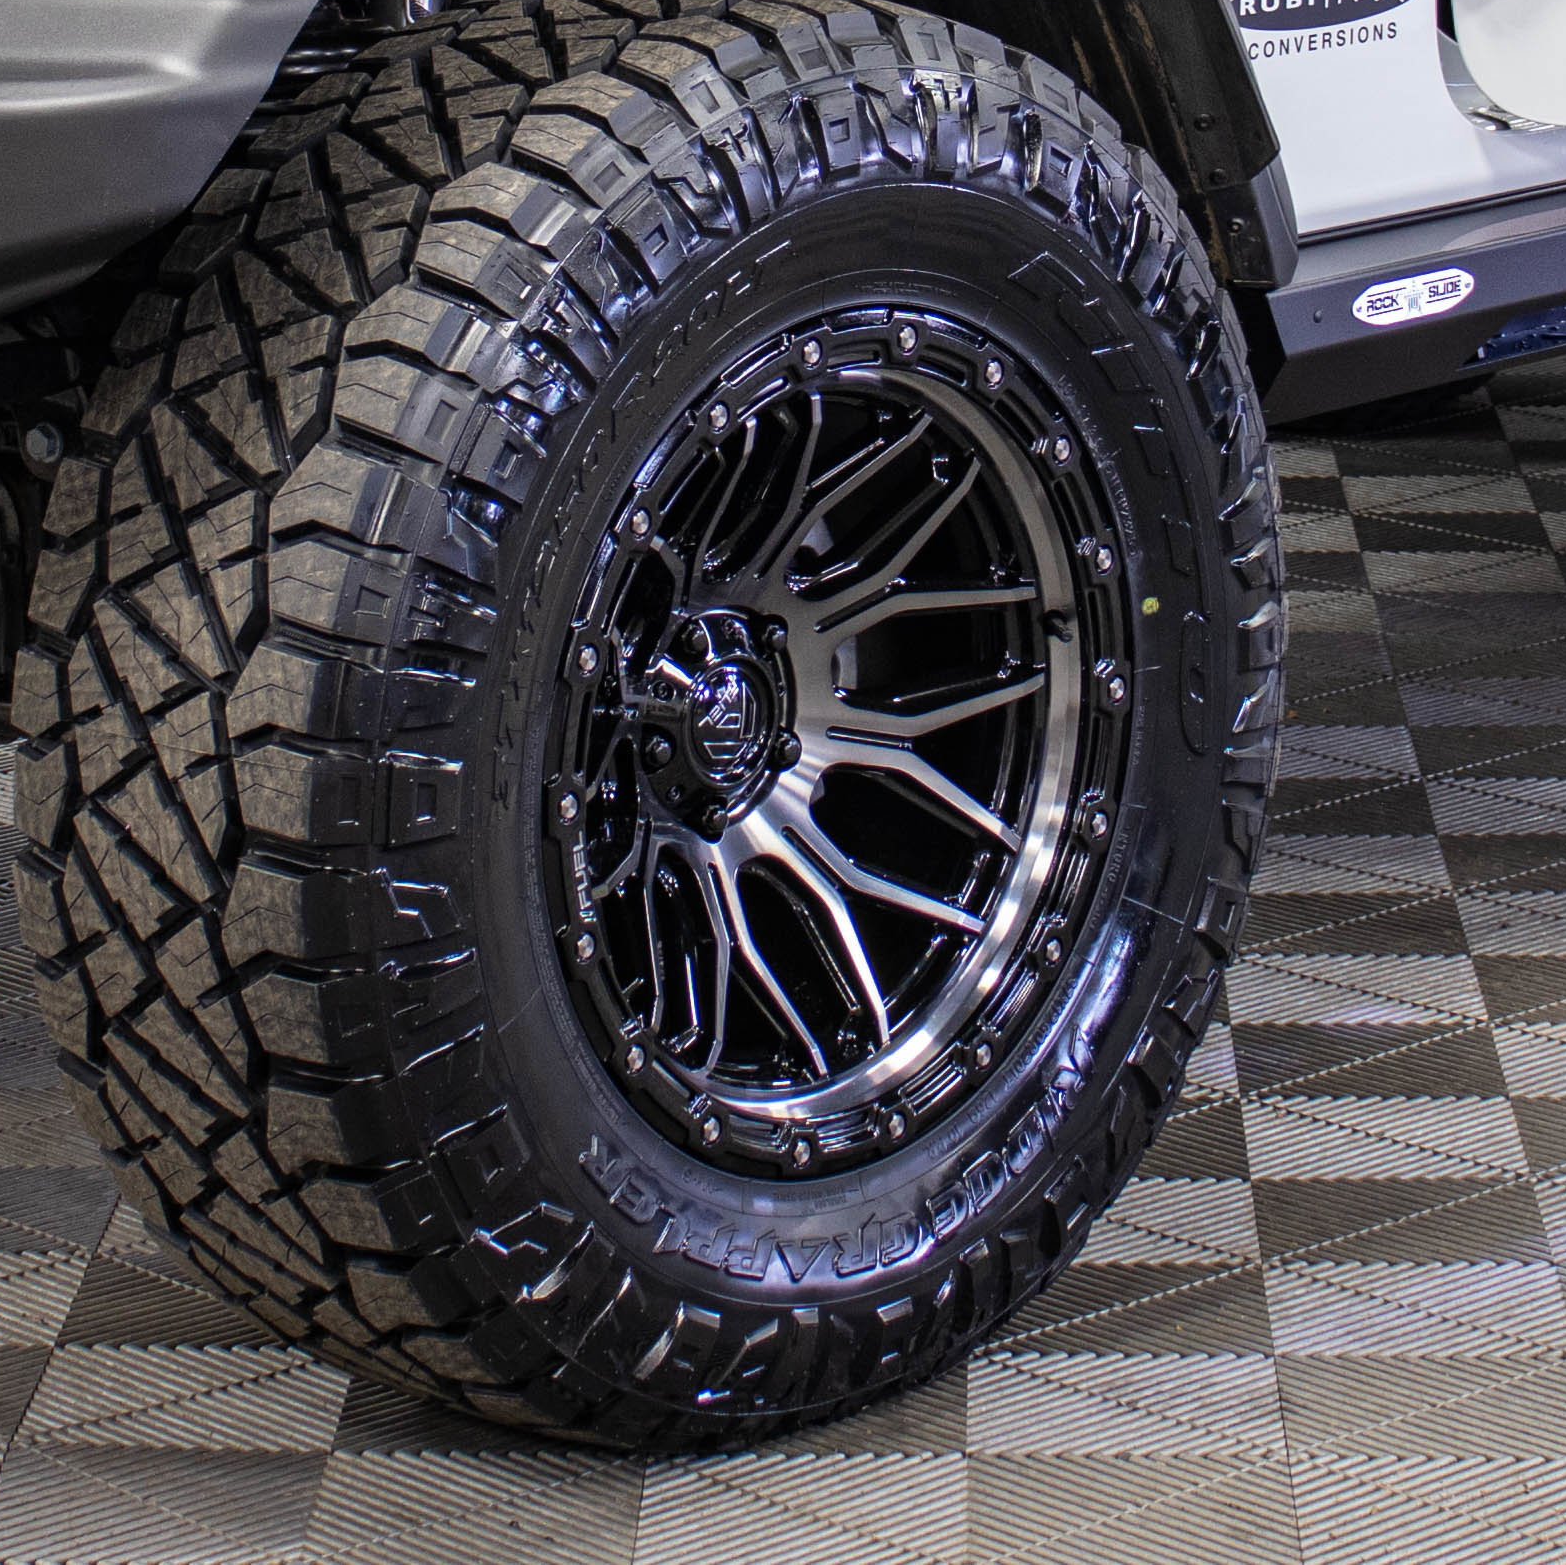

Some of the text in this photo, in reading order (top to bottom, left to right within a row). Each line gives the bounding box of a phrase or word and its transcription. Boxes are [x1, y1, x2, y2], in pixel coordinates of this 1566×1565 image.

[1248, 22, 1397, 60] CONVERSIONS
[1366, 279, 1461, 313] ROCK SLIDE
[573, 830, 592, 910] FUEL
[579, 1024, 1098, 1282] RIDGE GRAPPLER
